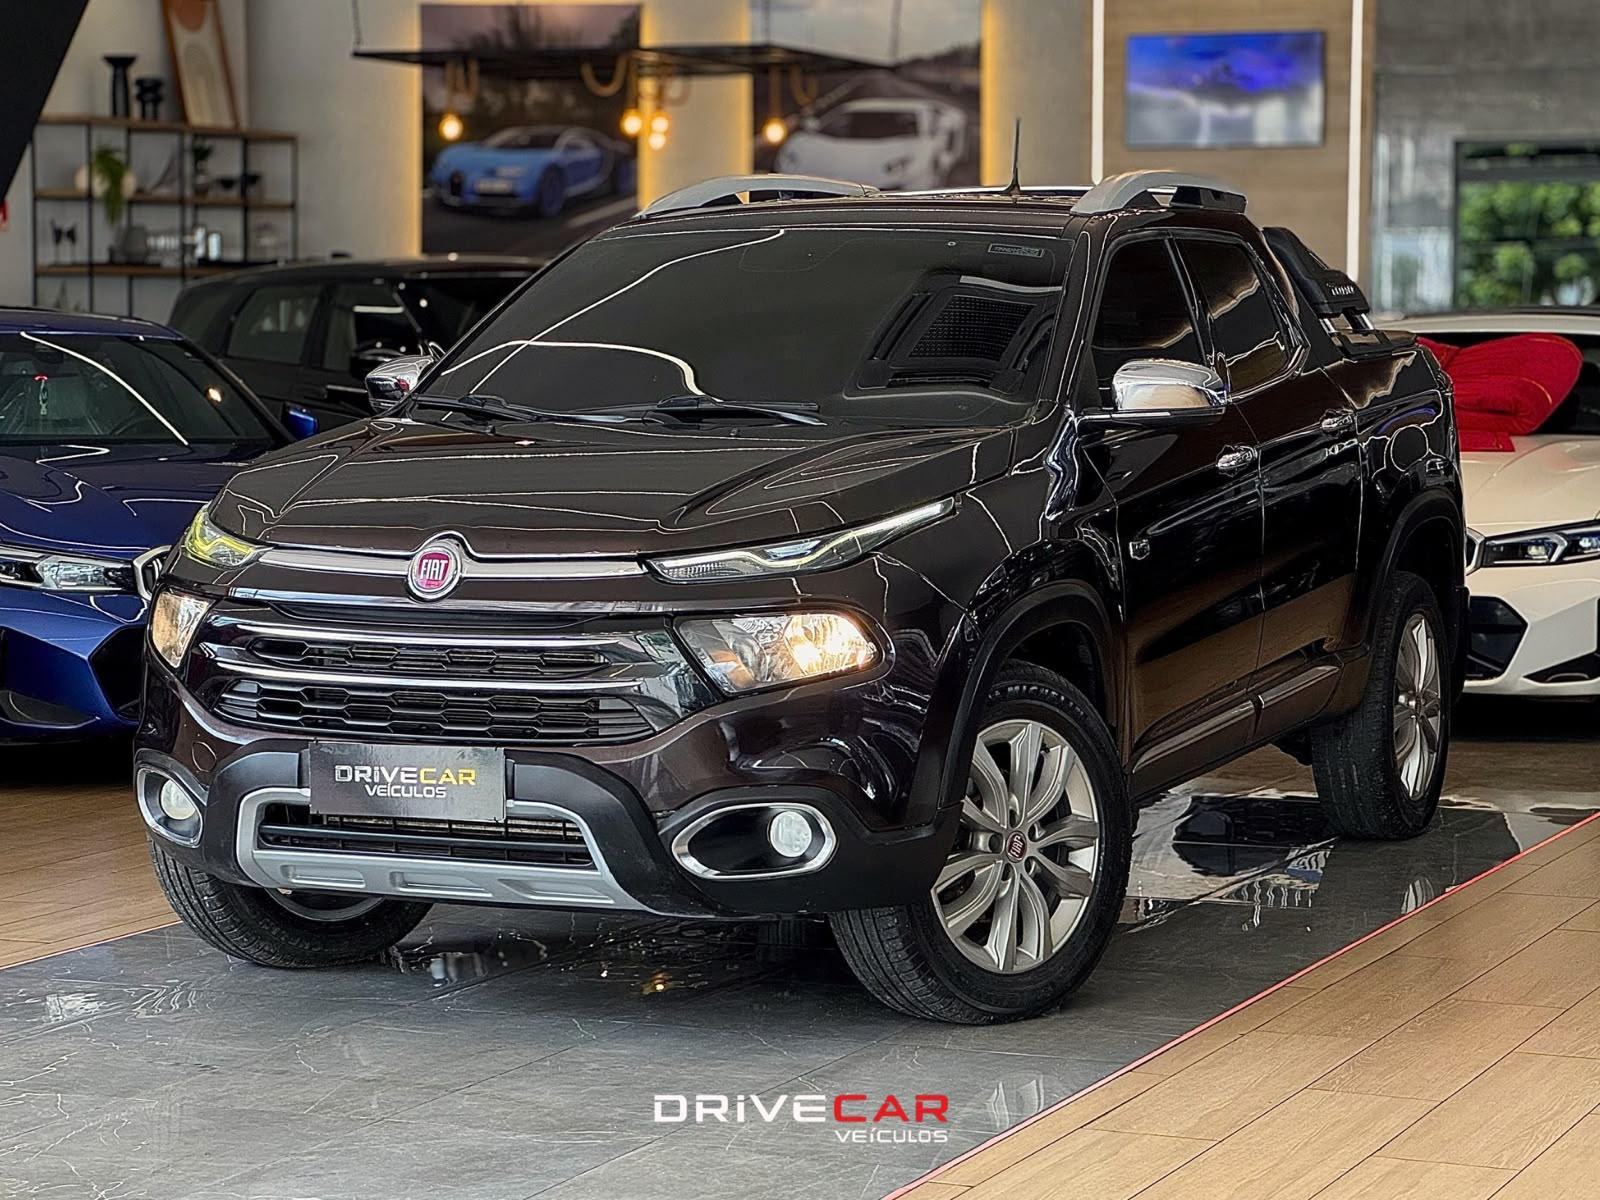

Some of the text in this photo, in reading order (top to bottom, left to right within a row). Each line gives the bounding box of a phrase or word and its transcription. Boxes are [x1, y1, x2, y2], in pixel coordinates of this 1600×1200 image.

[420, 559, 448, 580] FIAT
[365, 783, 447, 798] VEÍCULOS
[1010, 835, 1024, 857] FIAT
